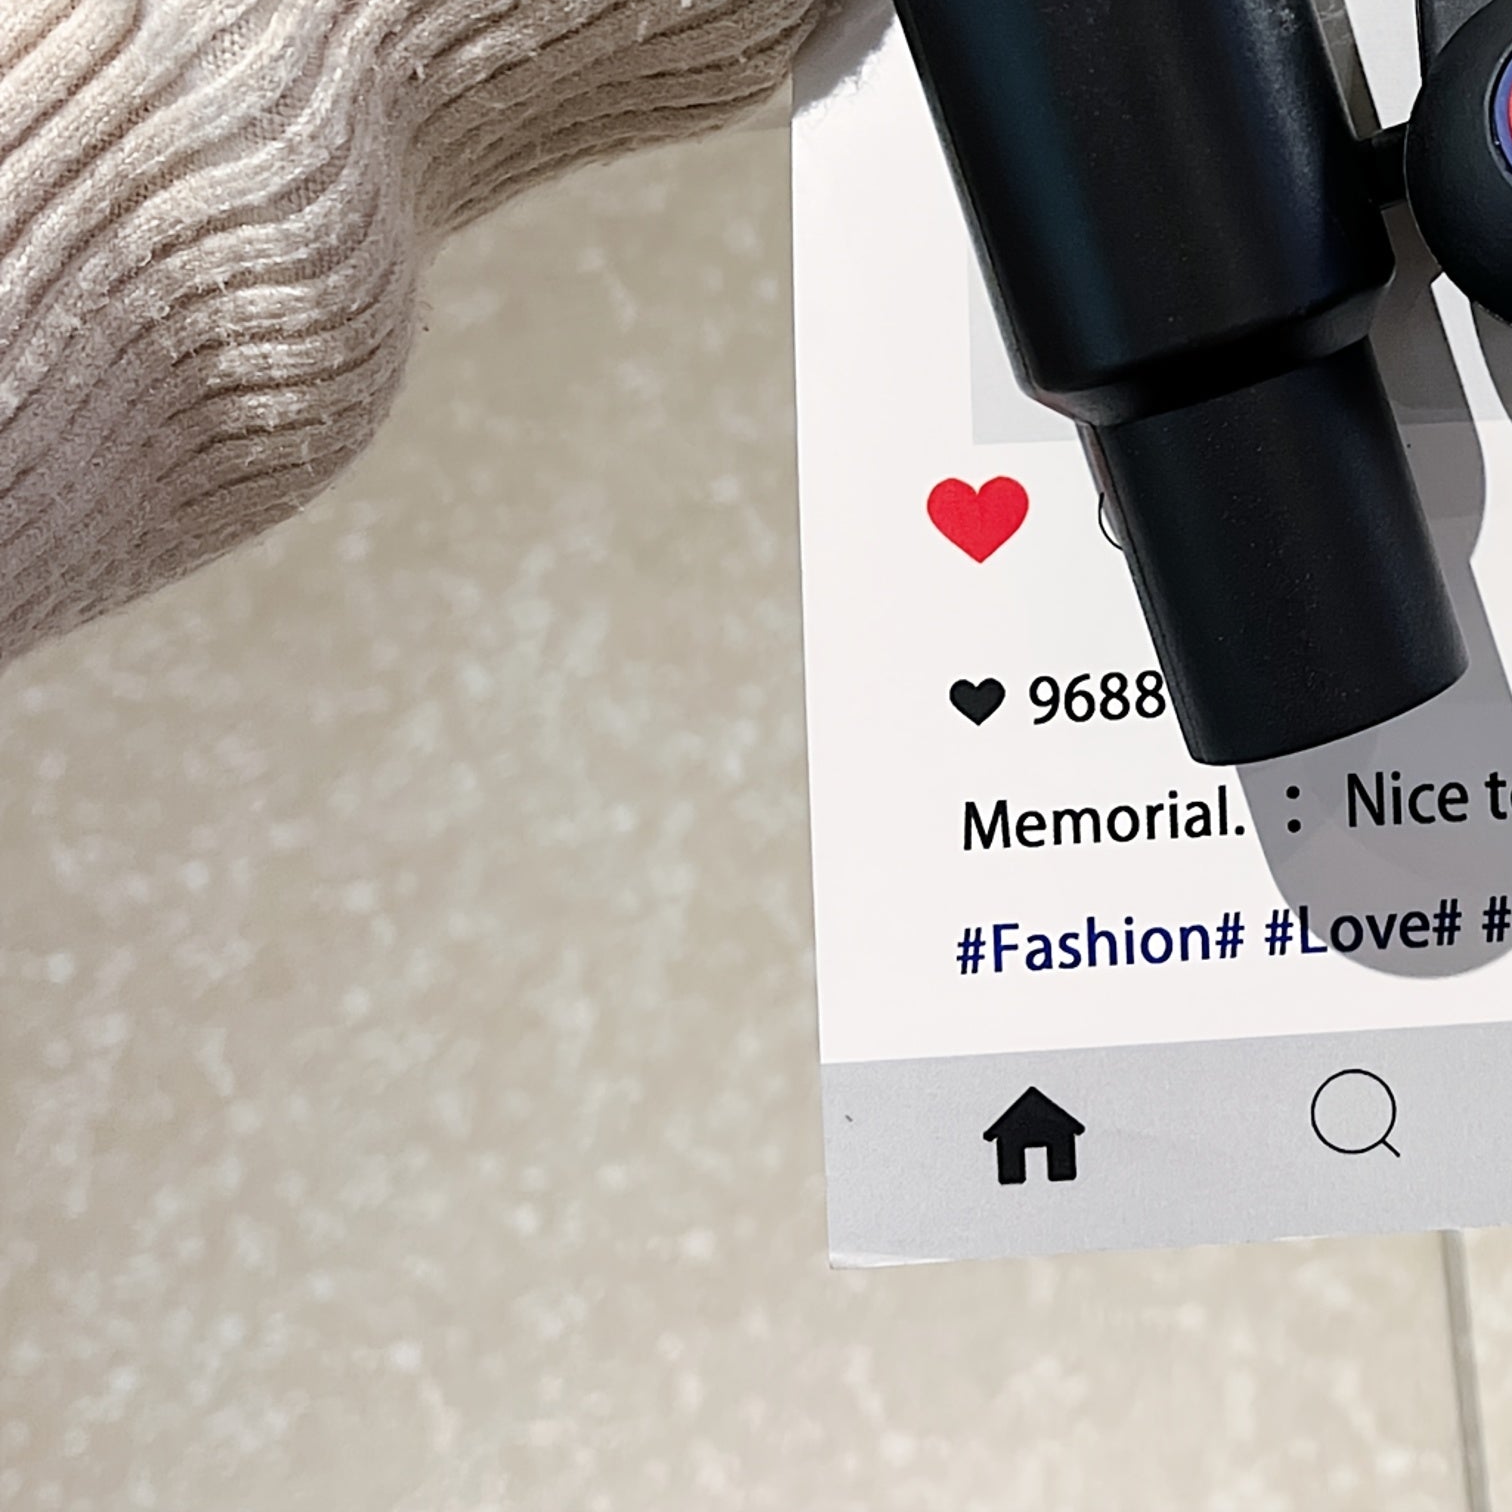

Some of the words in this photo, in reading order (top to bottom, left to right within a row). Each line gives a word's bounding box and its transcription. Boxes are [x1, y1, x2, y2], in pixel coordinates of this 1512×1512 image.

[1028, 669, 1167, 726] 9688
[961, 784, 1247, 852] Memorial.
[1346, 769, 1470, 829] Nice
[956, 911, 1246, 976] #Fashion#
[1264, 897, 1463, 957] #Love#
